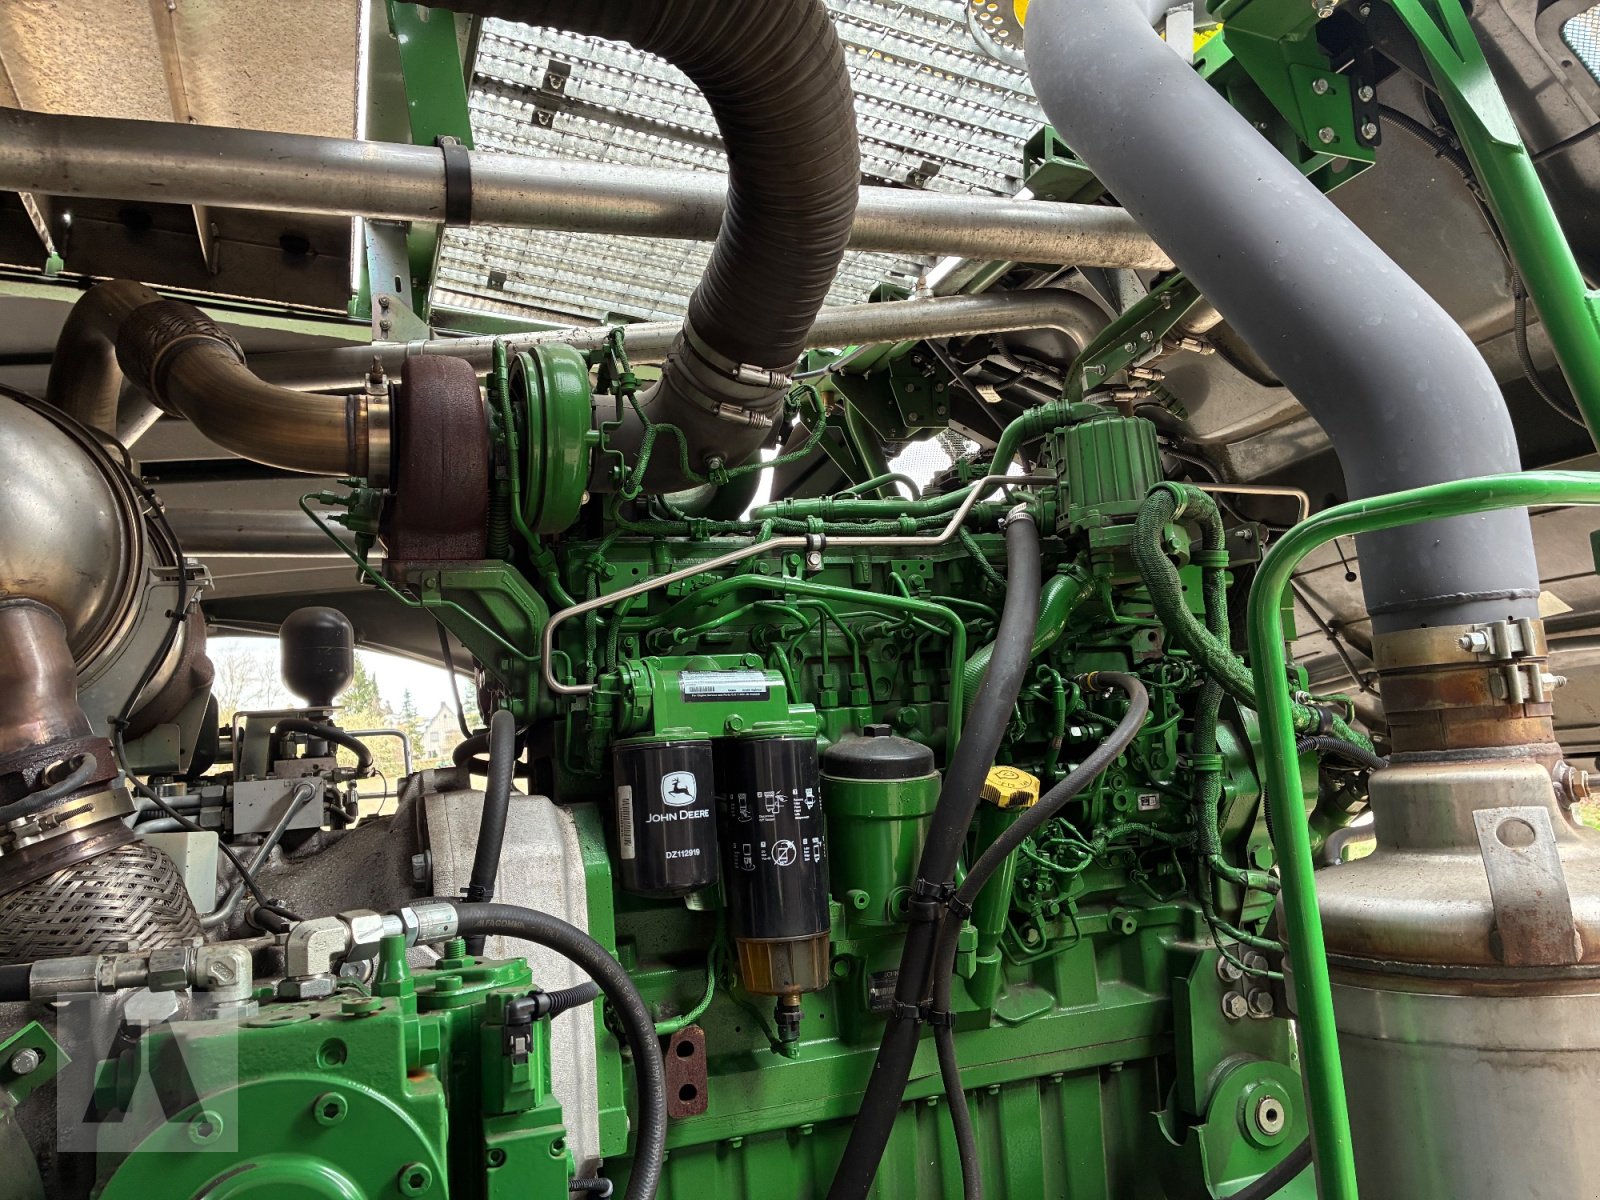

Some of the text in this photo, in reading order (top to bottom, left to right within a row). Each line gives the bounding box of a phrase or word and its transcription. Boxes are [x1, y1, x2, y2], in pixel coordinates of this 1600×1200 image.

[645, 809, 710, 823] JOHN DEERE
[665, 848, 701, 859] DZ112919
